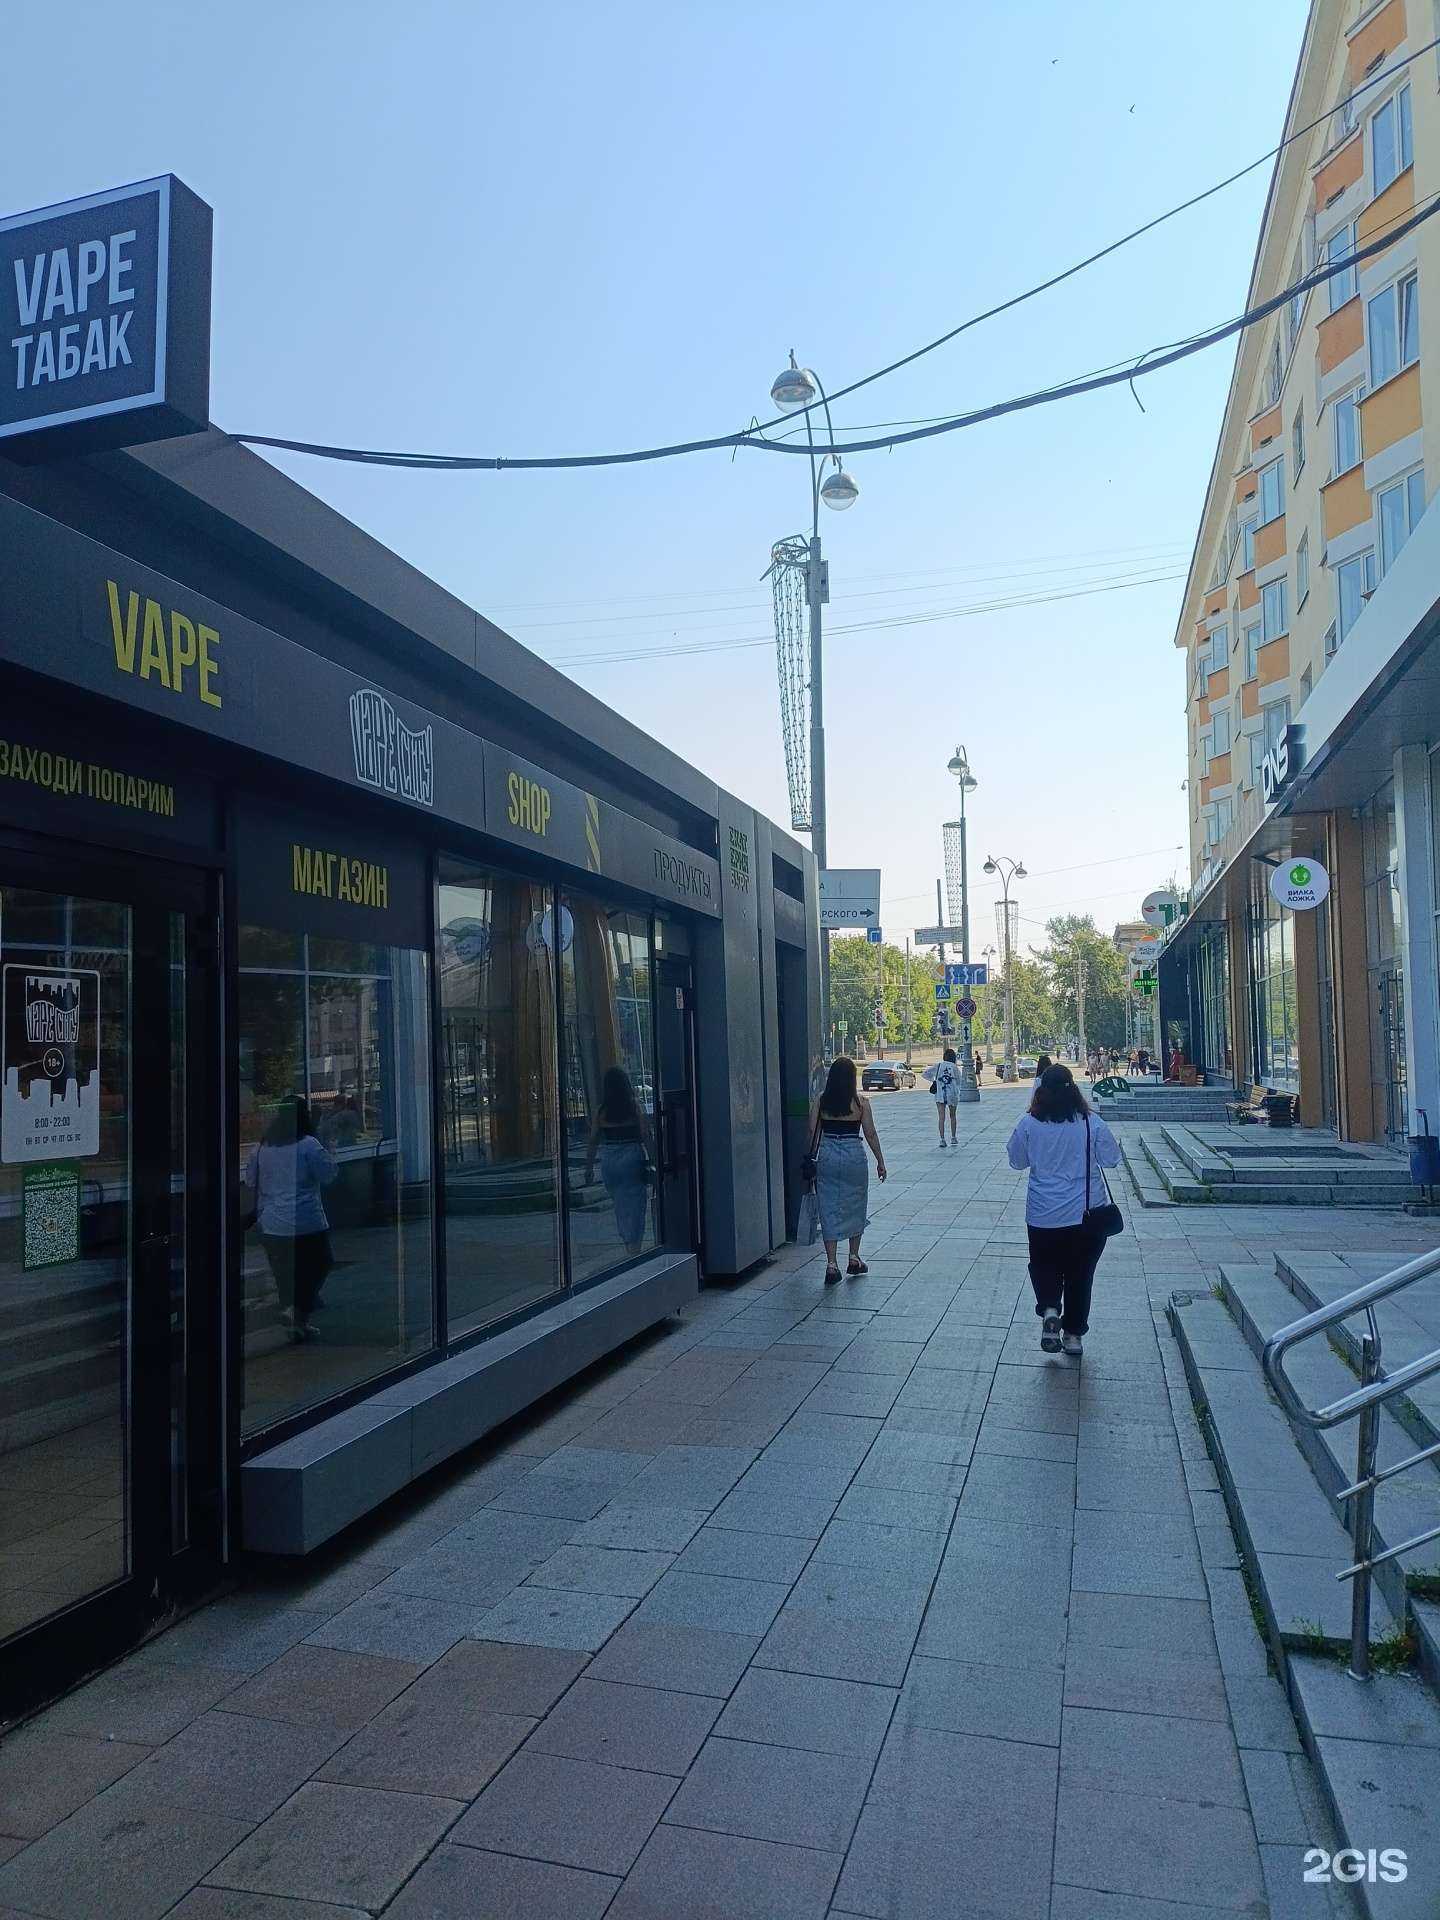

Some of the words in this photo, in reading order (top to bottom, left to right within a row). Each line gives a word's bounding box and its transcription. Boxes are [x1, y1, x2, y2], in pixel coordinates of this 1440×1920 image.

[14, 230, 136, 326] VAPE
[12, 311, 134, 390] ТАБАК
[107, 580, 222, 708] VAPE
[0, 740, 82, 794] ЗАХОДИ
[88, 764, 174, 817] ПОПАРИМ
[1262, 724, 1290, 804] DNS
[507, 772, 551, 836] SHOP
[293, 844, 388, 909] МАГАЗИН
[654, 848, 712, 900] ПРОДУКТЫ
[820, 910, 858, 918] РСКОГО
[48, 1058, 61, 1068] 18+
